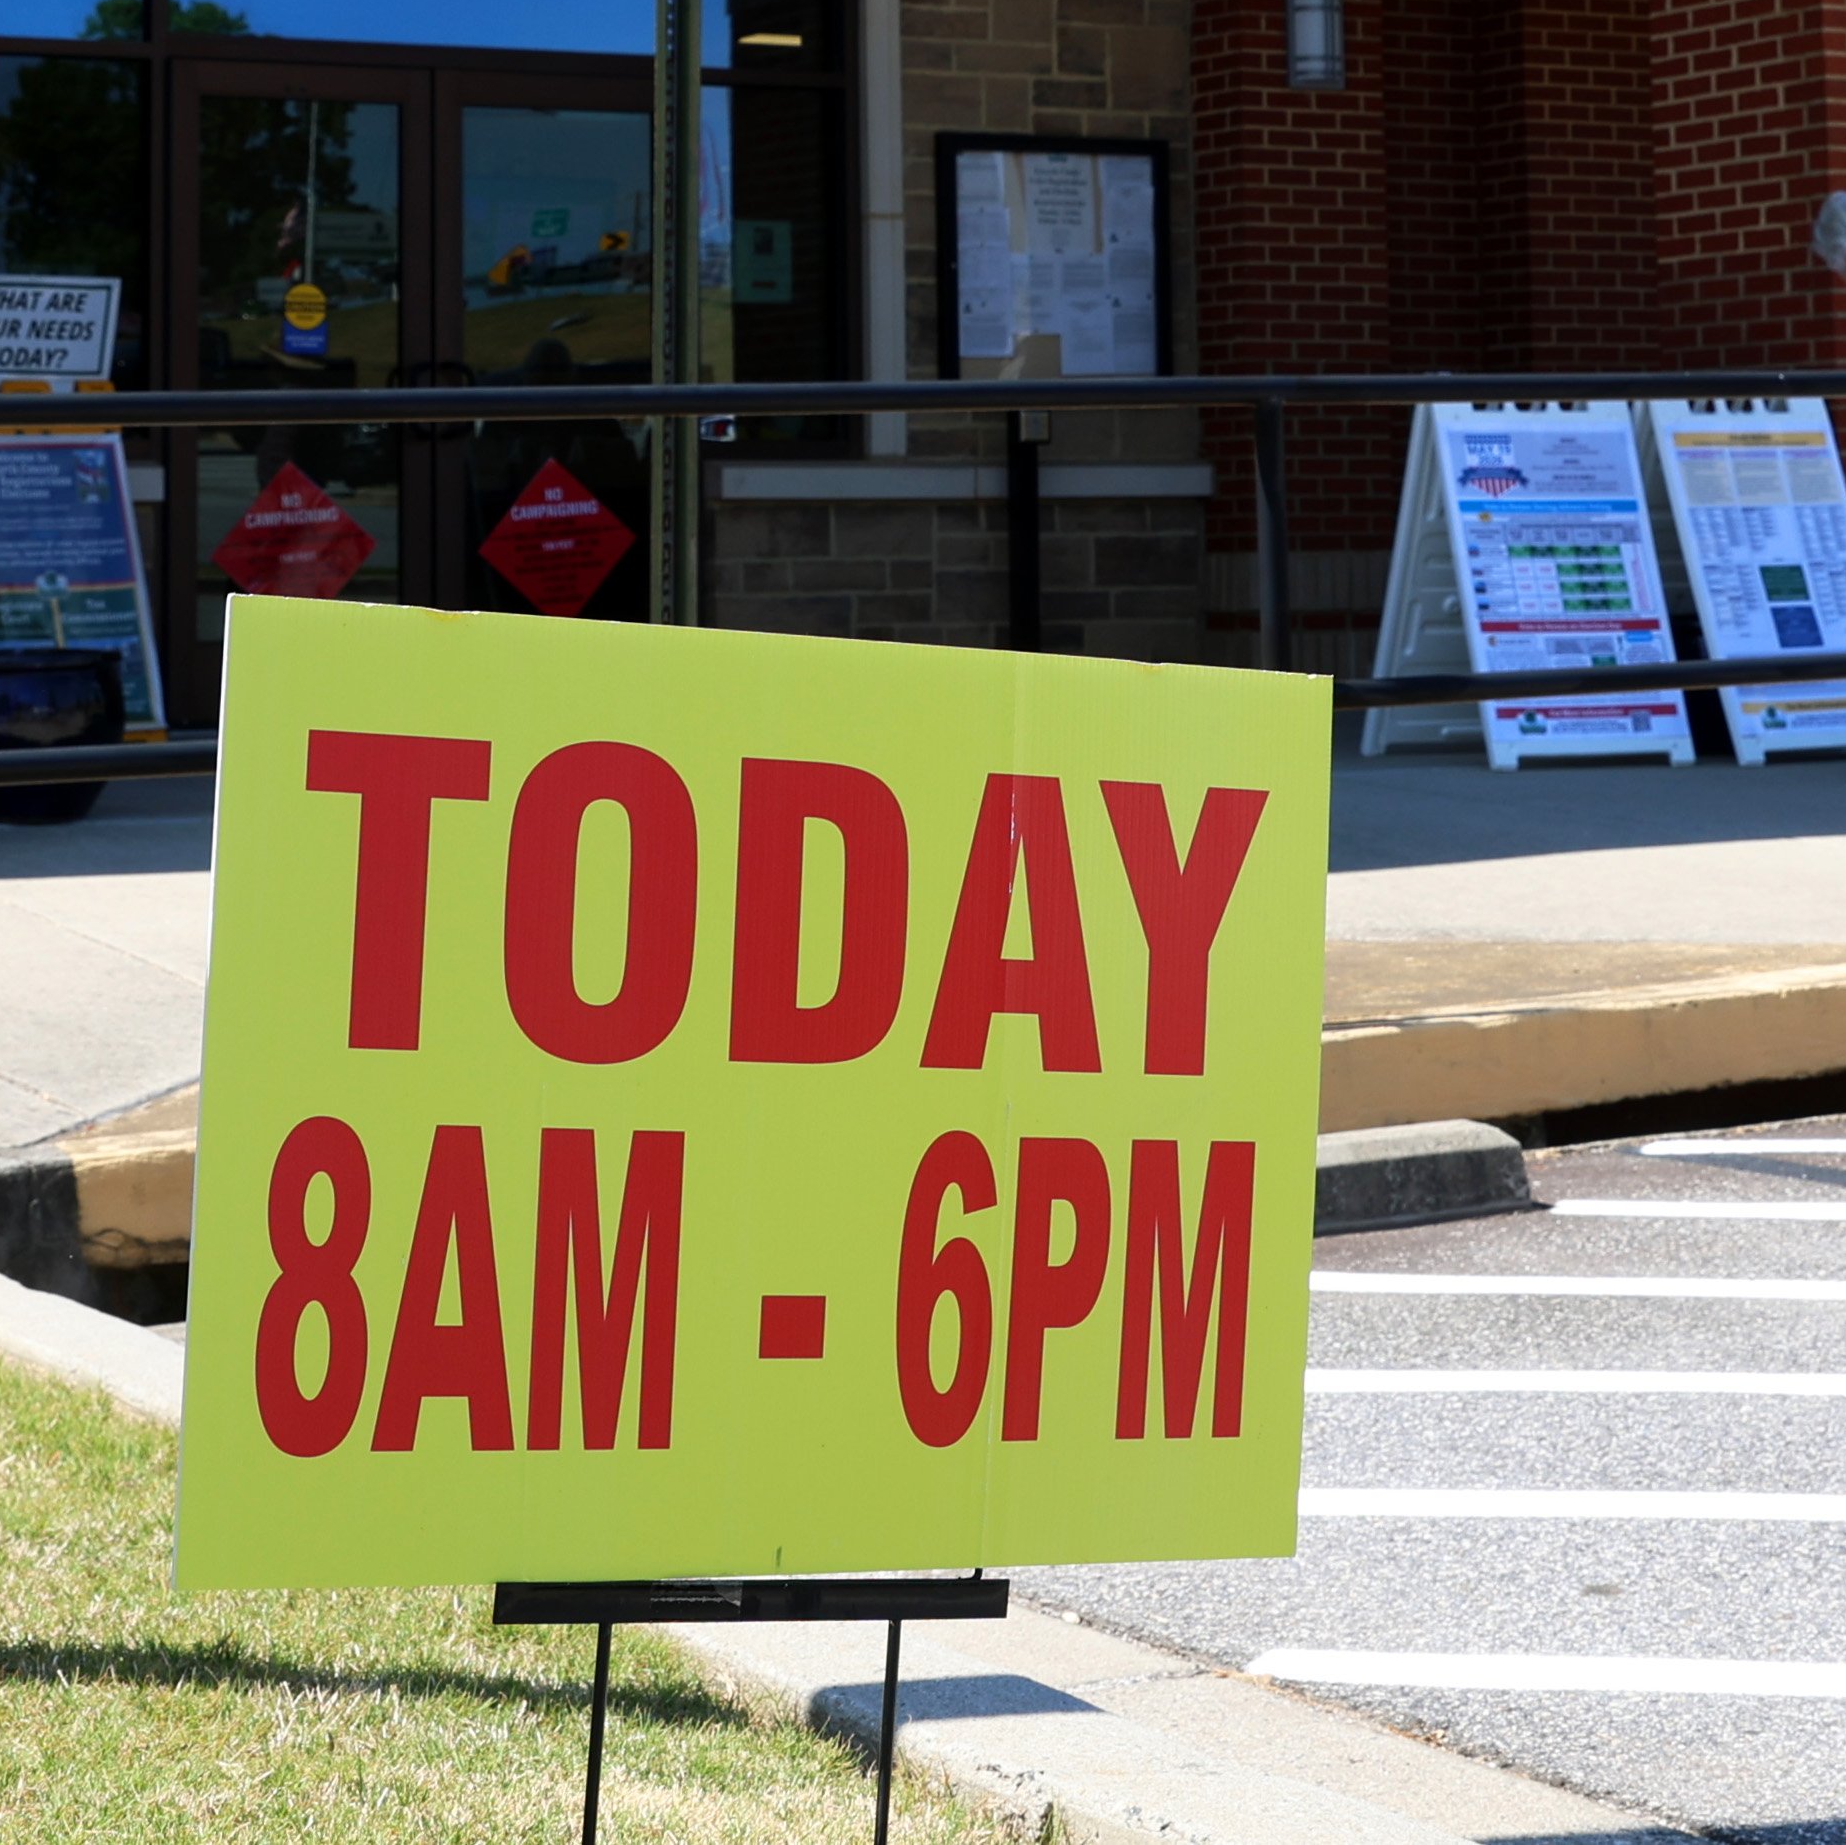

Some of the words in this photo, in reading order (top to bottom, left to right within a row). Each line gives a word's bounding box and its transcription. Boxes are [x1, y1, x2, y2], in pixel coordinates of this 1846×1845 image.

[44, 292, 88, 313] ARE
[26, 319, 95, 341] NEEDS
[280, 492, 302, 508] NO
[544, 487, 563, 502] NO
[510, 499, 600, 521] CAMPAIGNING
[305, 727, 1270, 1077] TODAY
[255, 1115, 685, 1458] 8AM
[759, 1295, 826, 1359] -
[896, 1130, 1256, 1448] 6PM
